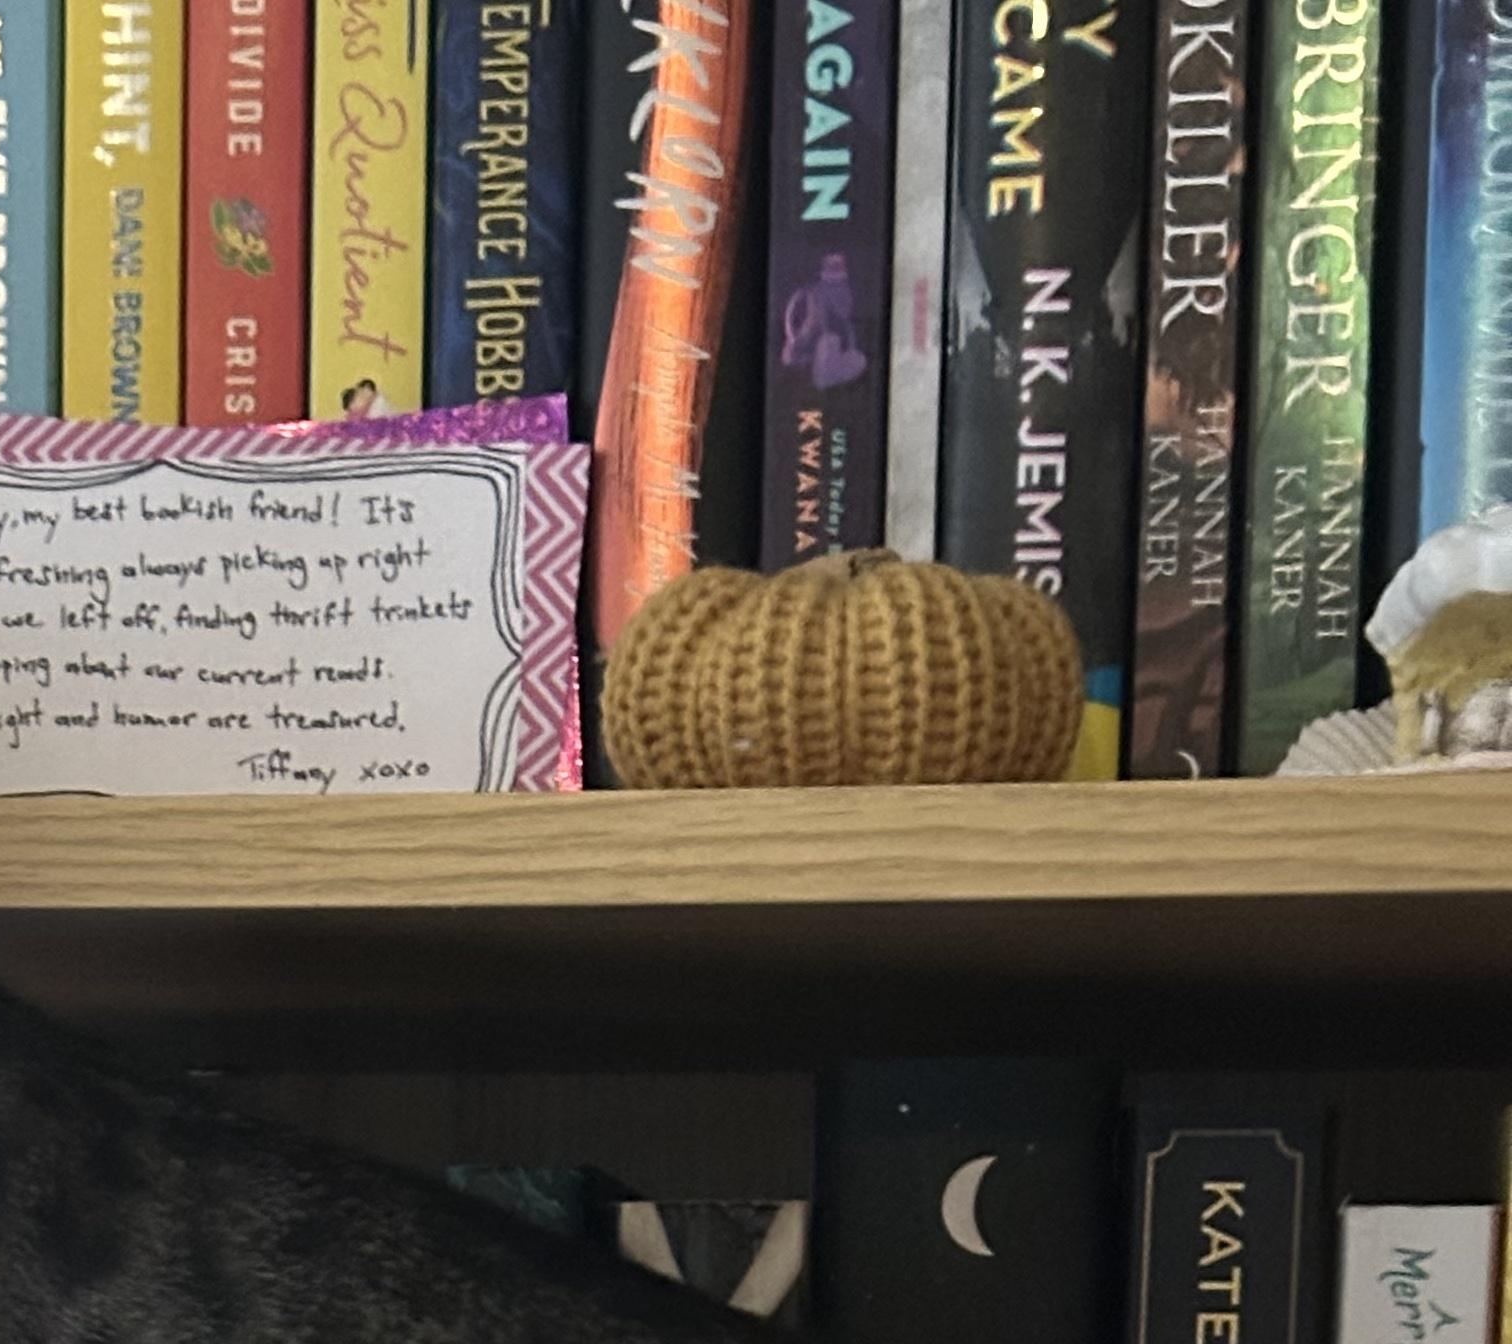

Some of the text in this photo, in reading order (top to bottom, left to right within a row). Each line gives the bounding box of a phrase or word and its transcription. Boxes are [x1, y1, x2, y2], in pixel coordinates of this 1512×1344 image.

[801, 0, 855, 223] AGAIN
[329, 82, 408, 359] Quotient
[72, 495, 128, 522] best
[141, 494, 234, 523] bookish
[249, 489, 341, 527] friend!
[1144, 434, 1182, 583] KANER
[1190, 401, 1228, 608] HANNAH
[121, 552, 207, 589] always
[219, 544, 309, 590] picking
[318, 556, 349, 582] up
[357, 536, 432, 582] right
[0, 610, 44, 629] we
[59, 600, 111, 631] left
[173, 604, 258, 640] finding
[269, 598, 355, 627] thrift
[369, 590, 474, 623] trinkets
[64, 652, 131, 680] about
[143, 663, 183, 681] our
[196, 657, 301, 687] current
[53, 702, 101, 729] and
[113, 704, 198, 729] humor
[206, 711, 252, 731] are
[265, 700, 407, 734] treasured.
[236, 747, 432, 795] Tiffany xoxo
